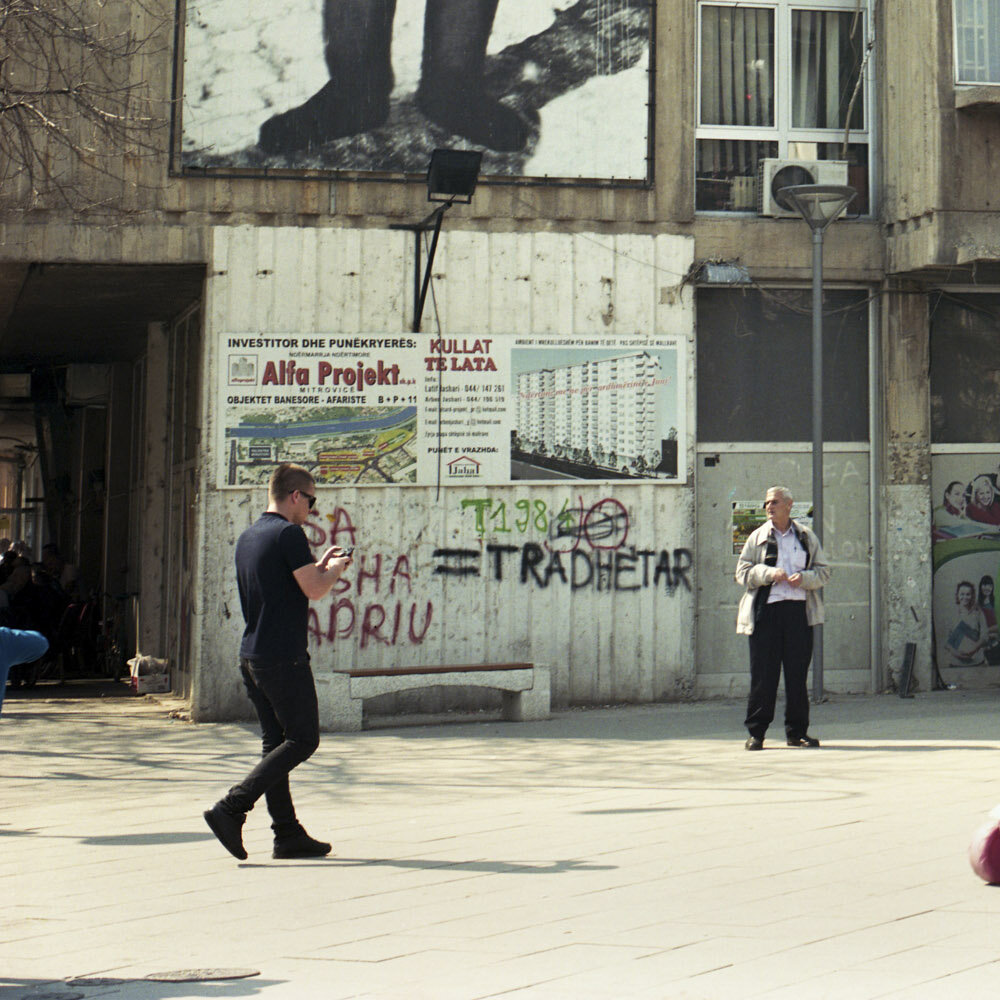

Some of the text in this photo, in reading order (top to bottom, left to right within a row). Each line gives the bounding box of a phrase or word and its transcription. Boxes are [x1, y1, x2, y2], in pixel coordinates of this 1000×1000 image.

[228, 337, 416, 348] INVESTITOR DHE PUNËKRYERËS:
[430, 339, 493, 354] KULLAT
[424, 357, 498, 371] TE LATA
[262, 360, 310, 386] Alfa
[318, 360, 400, 391] Projekt
[227, 396, 272, 404] OBJEKTET
[274, 396, 320, 404] BANESORE
[327, 396, 366, 404] AFARISTE
[378, 396, 384, 404] B
[393, 396, 399, 404] P
[408, 396, 417, 404] 11
